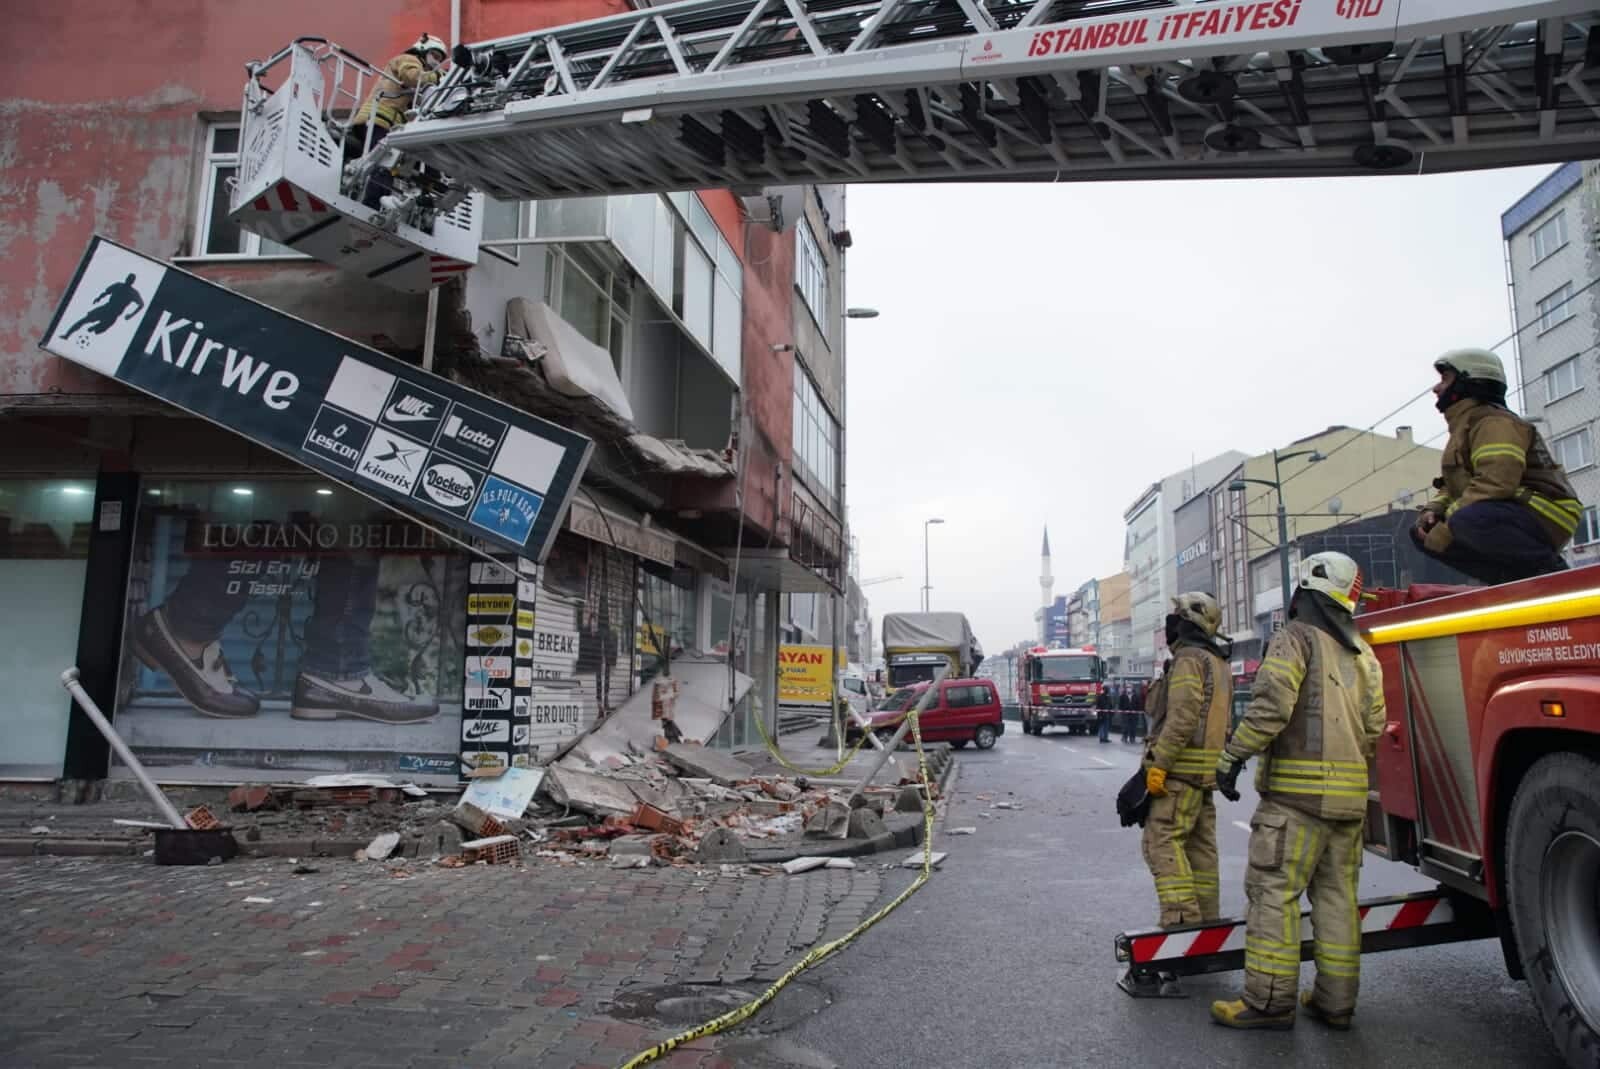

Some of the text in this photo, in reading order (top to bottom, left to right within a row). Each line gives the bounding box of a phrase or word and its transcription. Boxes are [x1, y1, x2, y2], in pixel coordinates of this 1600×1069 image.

[144, 310, 299, 410] Kirwe
[396, 395, 435, 416] NIKE
[309, 429, 359, 461] Lescon
[363, 462, 412, 489] kinetix
[497, 488, 518, 505] POLO
[203, 523, 339, 549] LUCIANO
[266, 560, 290, 574] En
[538, 632, 574, 654] BREAK
[536, 704, 579, 723] GROUND
[472, 722, 500, 731] NIKE
